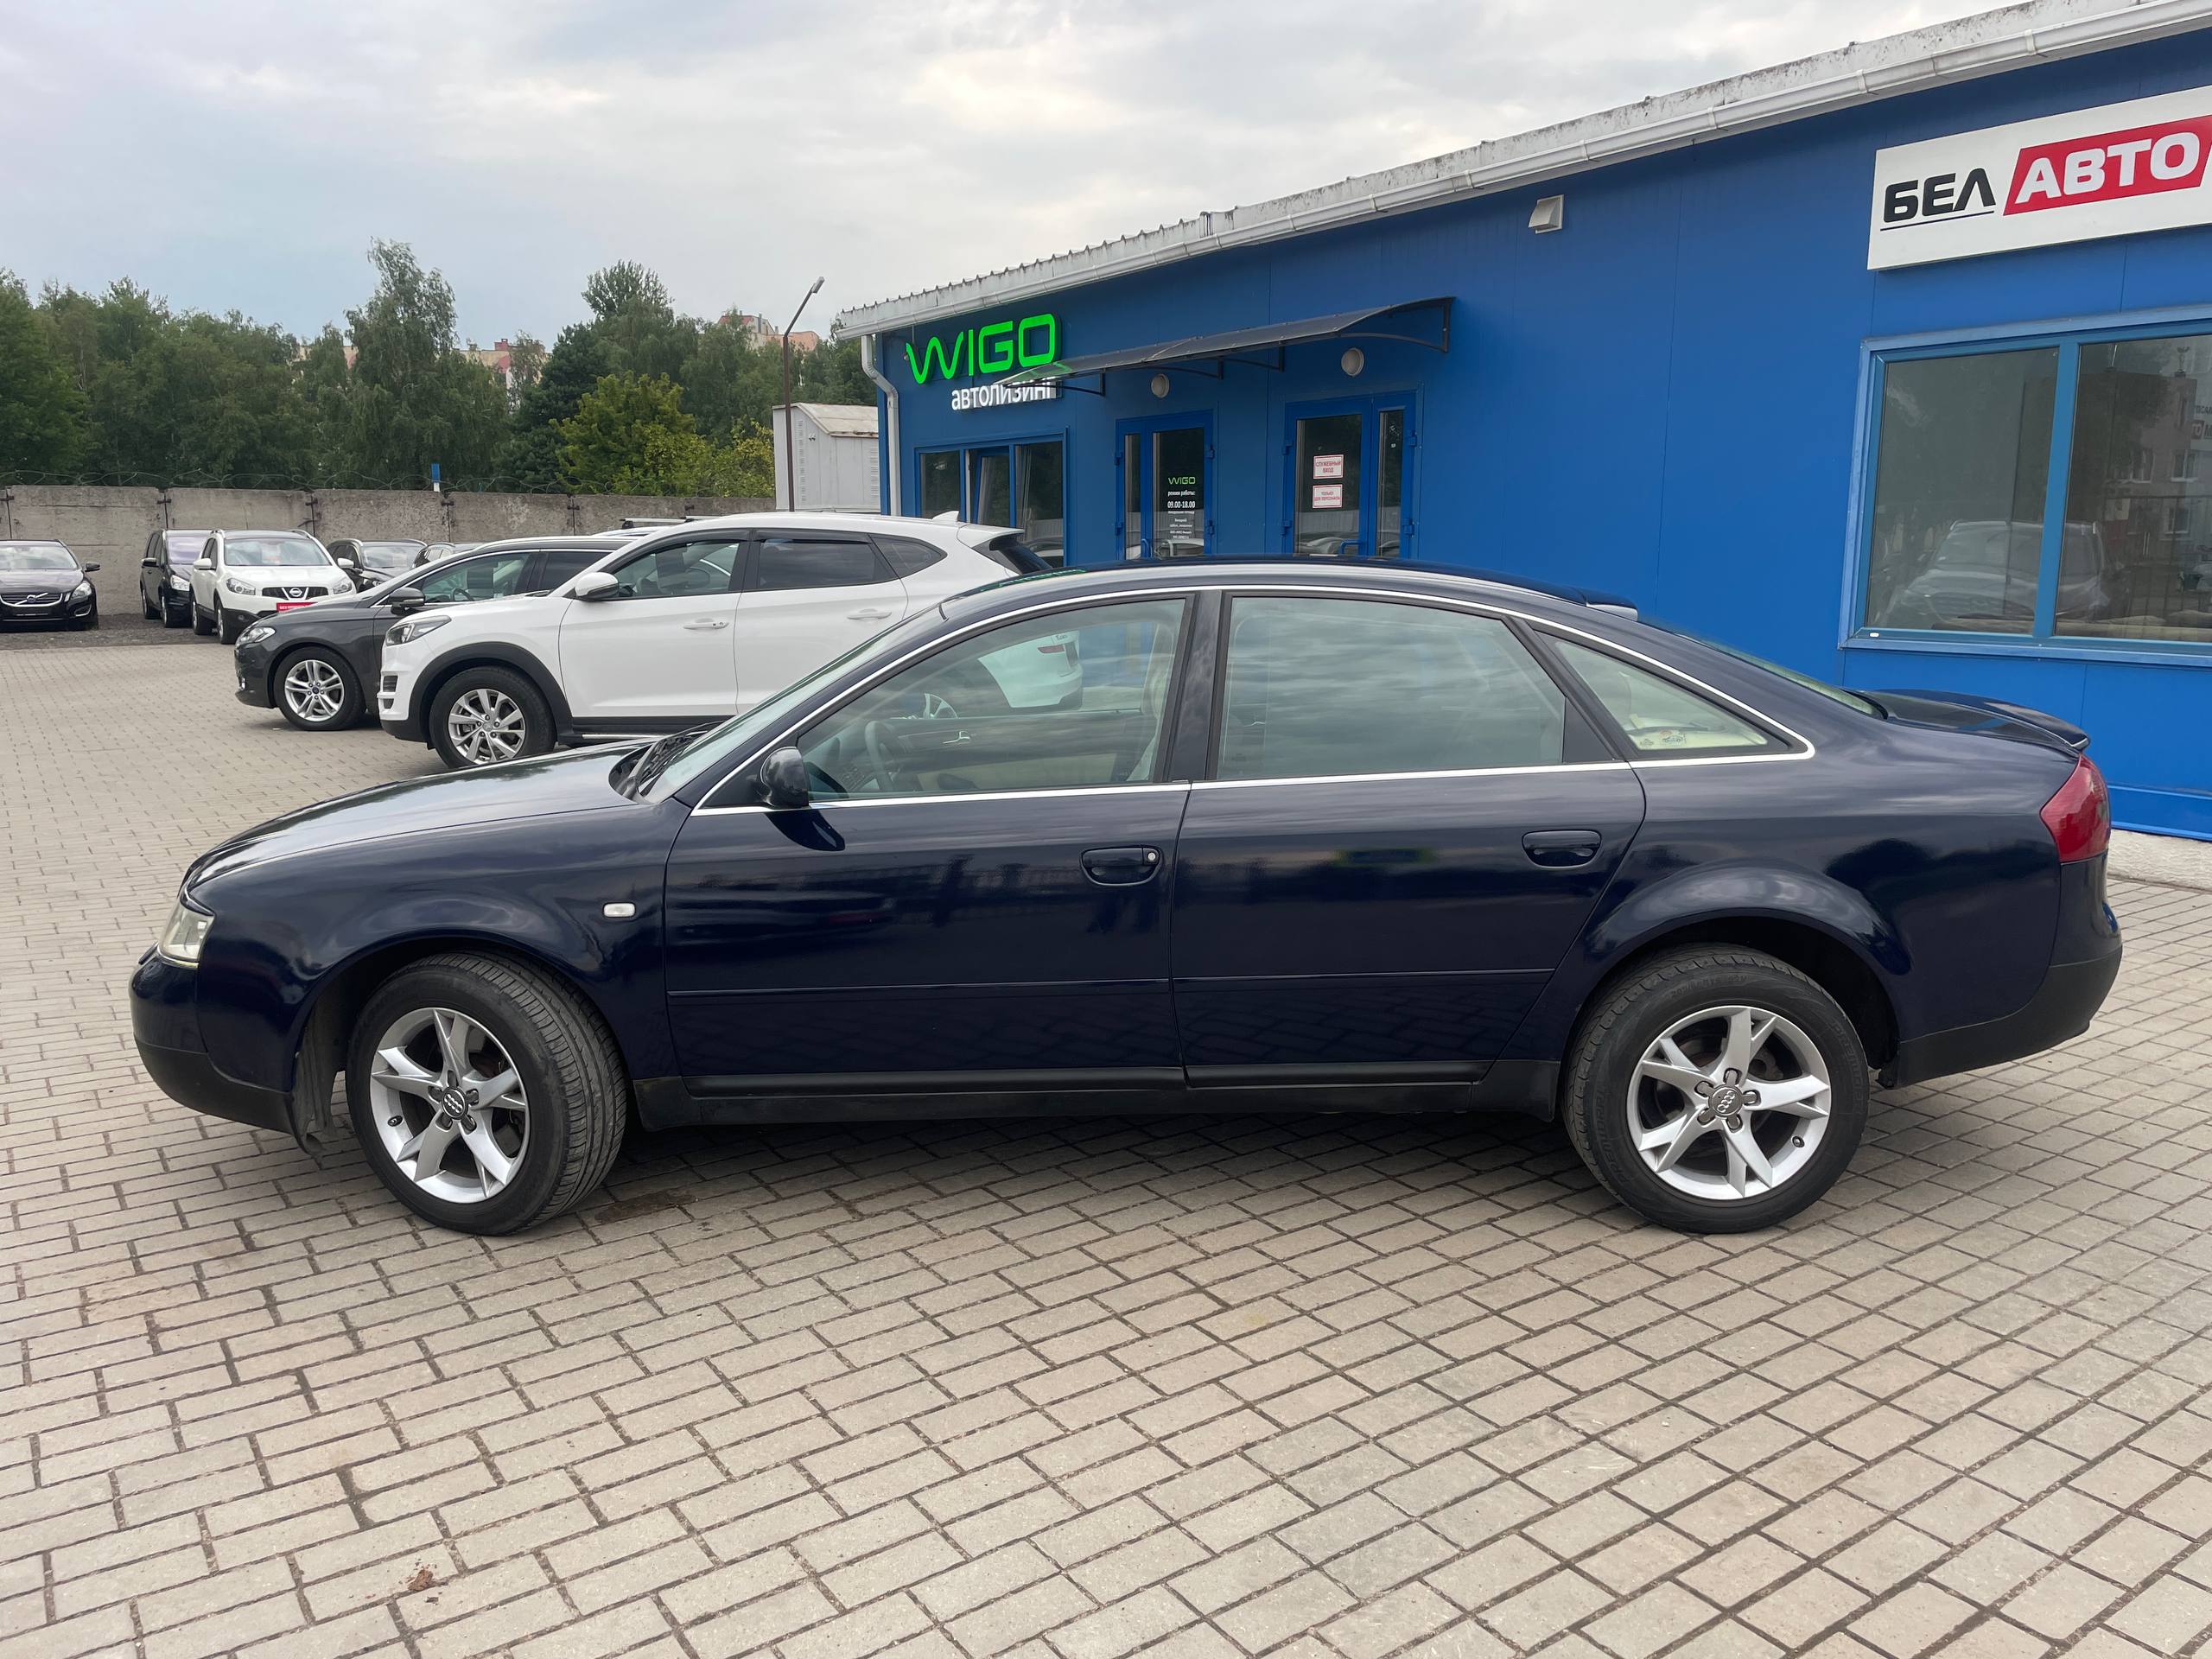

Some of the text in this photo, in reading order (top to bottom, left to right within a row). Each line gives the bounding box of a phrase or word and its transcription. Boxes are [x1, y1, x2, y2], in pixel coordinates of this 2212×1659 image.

[1884, 131, 2200, 223] БЕЛ АВТО
[906, 313, 1057, 385] WIGO
[1167, 476, 1196, 485] WIGO
